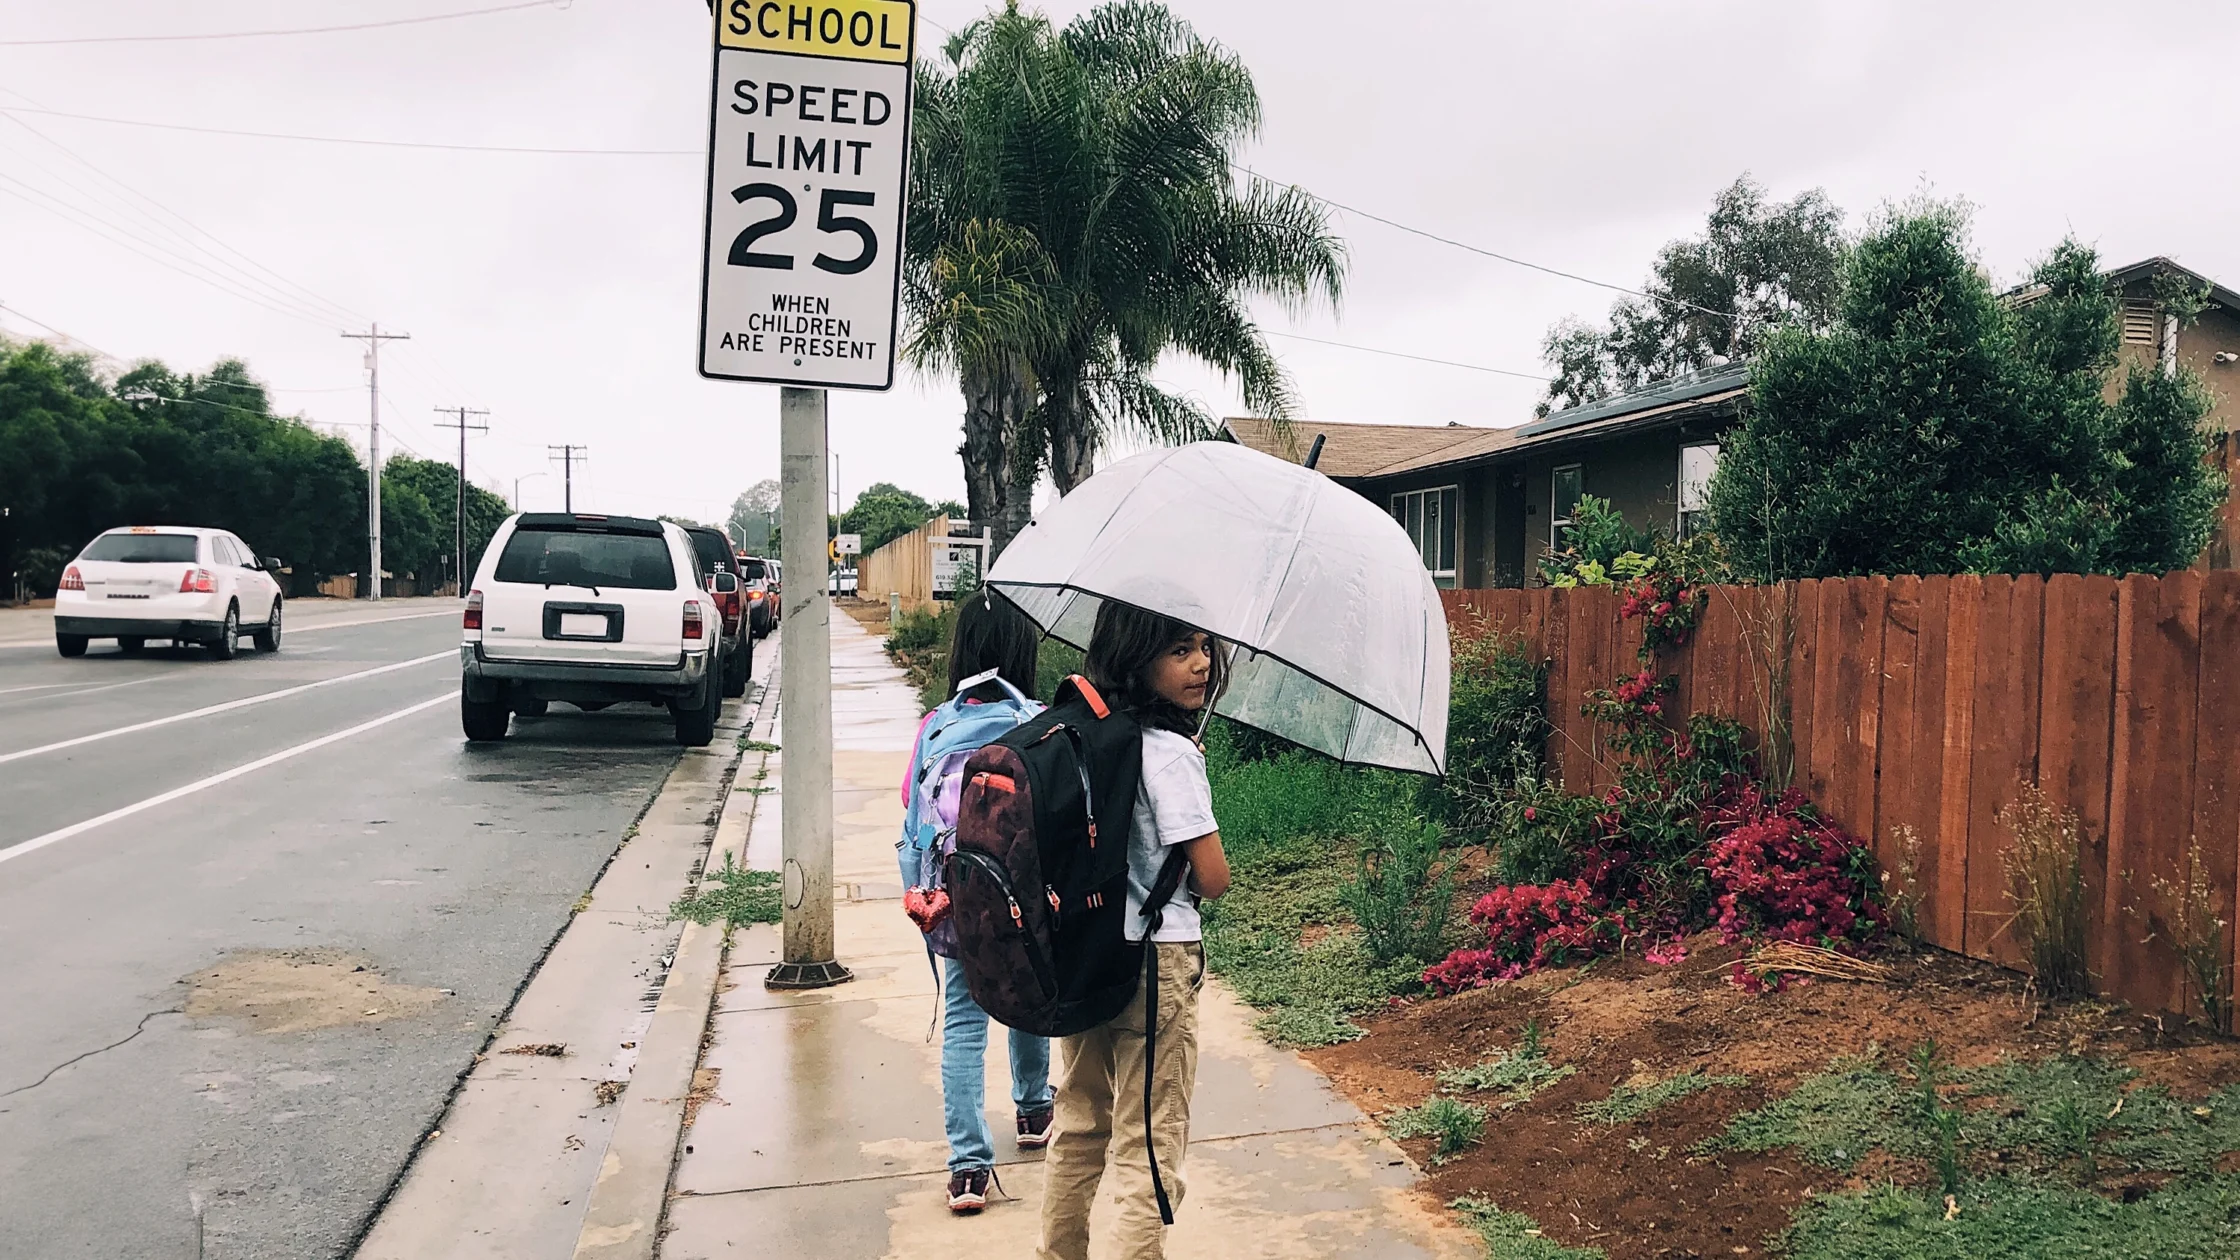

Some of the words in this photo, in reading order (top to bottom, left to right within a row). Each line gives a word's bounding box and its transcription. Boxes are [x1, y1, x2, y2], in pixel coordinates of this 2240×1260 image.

[728, 0, 902, 50] SCHOOL
[730, 79, 891, 126] SPEED
[746, 131, 872, 176] LIMIT
[727, 182, 878, 276] 25
[748, 313, 851, 338] CHILDREN
[772, 293, 830, 315] WHEN
[720, 331, 764, 353] ARE
[779, 335, 877, 360] PRESENT
